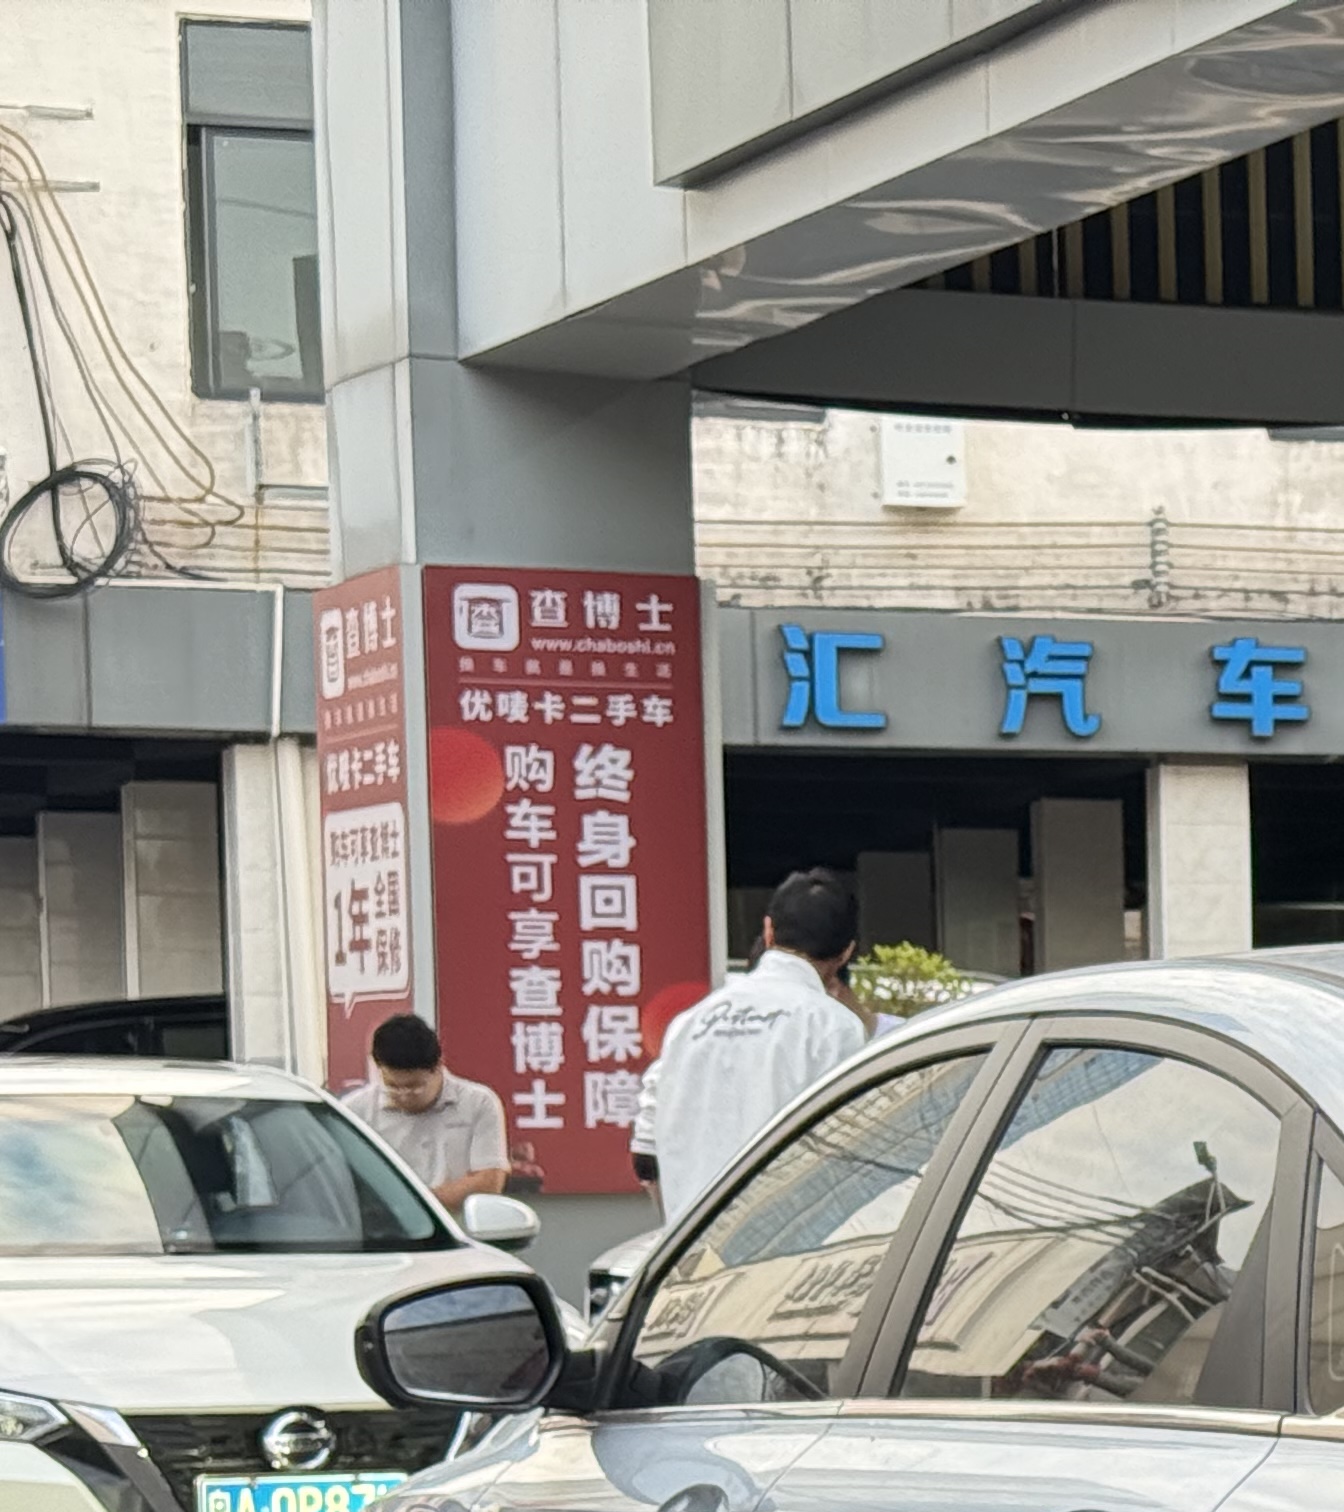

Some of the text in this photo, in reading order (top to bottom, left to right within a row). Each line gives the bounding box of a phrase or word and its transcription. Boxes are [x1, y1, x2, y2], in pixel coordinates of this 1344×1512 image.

[459, 687, 674, 728] 优唛卡二手车
[528, 587, 674, 632] 查博士
[503, 742, 566, 1131] 购车可享查博士
[572, 742, 645, 1131] 终身回购保障
